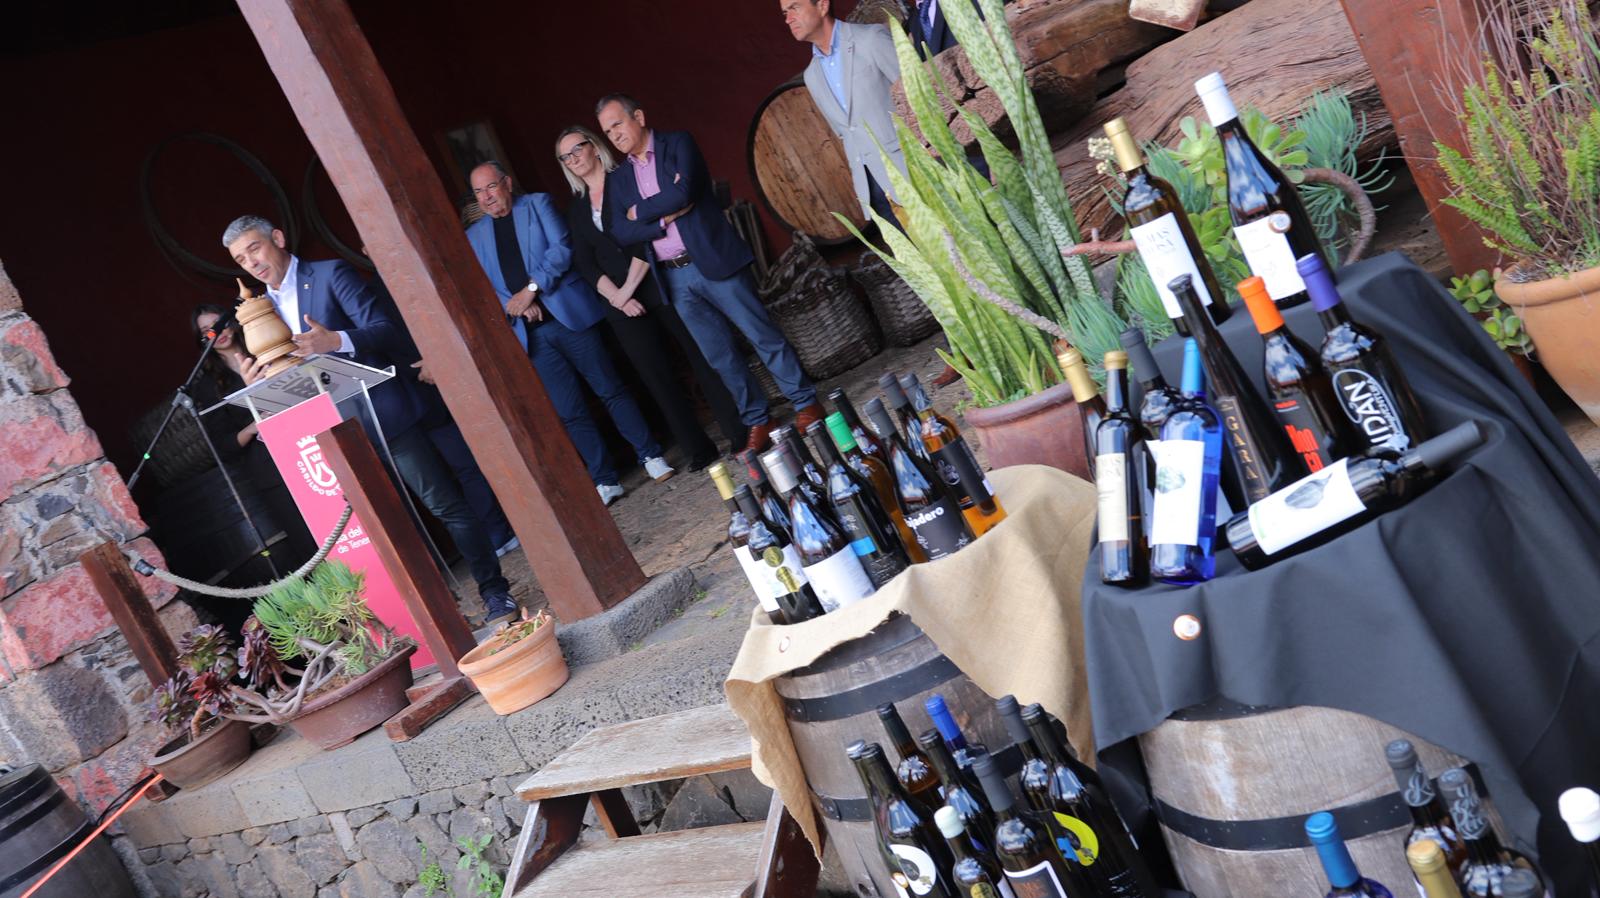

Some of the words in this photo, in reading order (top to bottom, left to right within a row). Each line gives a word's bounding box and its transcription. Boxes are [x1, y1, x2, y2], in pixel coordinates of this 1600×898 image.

[1226, 416, 1258, 479] GARA
[297, 461, 325, 495] CABILDO
[348, 526, 363, 538] del
[338, 545, 349, 553] de
[348, 537, 370, 549] Tener
